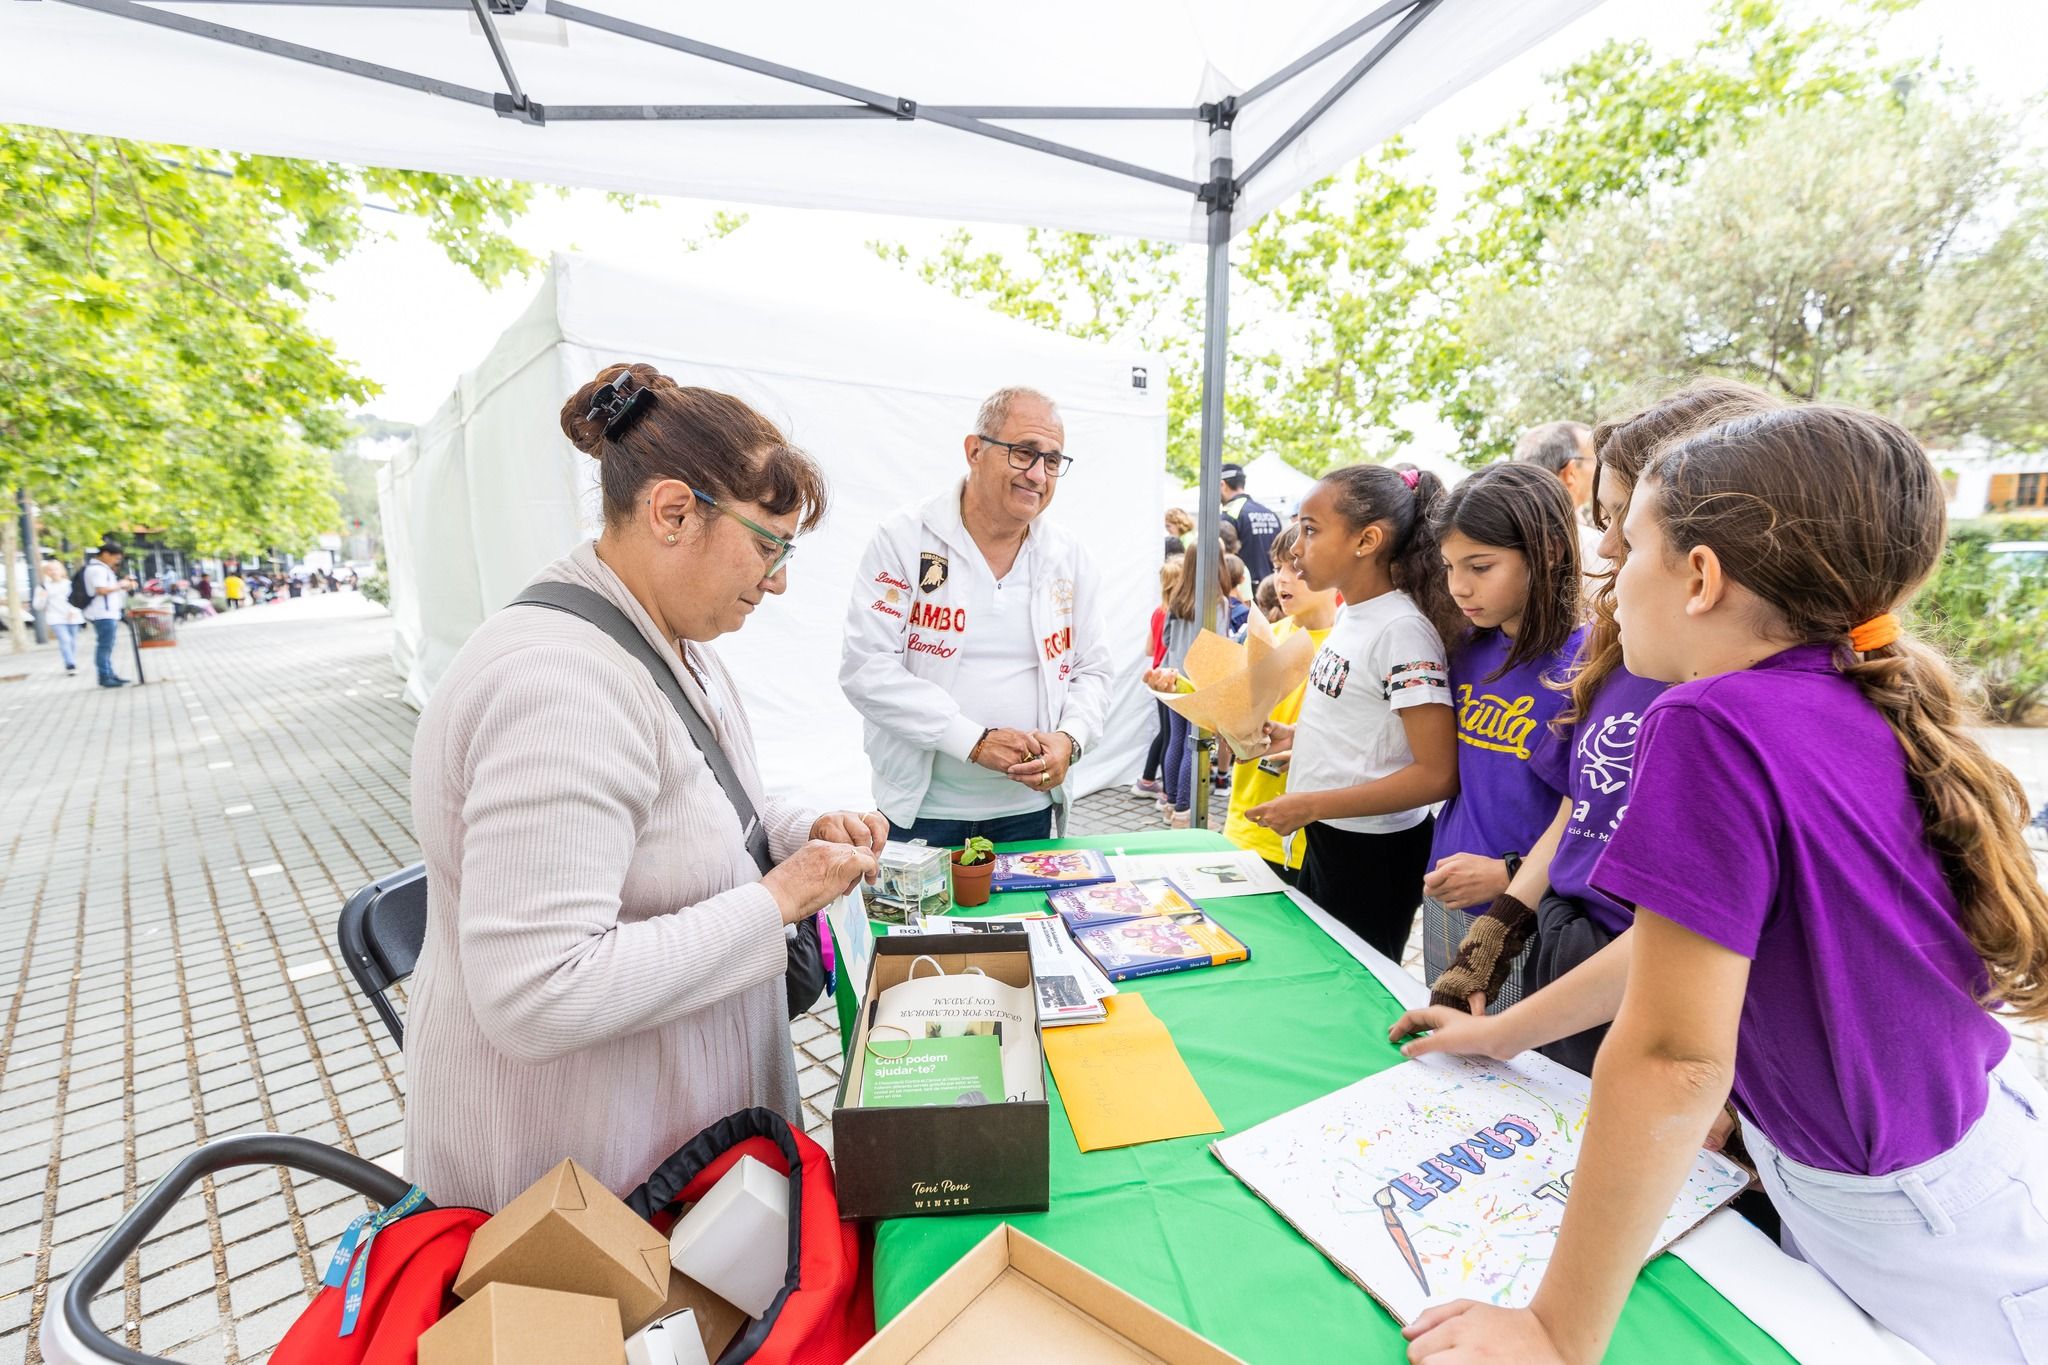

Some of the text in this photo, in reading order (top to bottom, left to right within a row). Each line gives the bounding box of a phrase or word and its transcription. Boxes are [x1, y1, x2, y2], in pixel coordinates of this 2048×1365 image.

[875, 571, 910, 590] Lambo
[871, 599, 903, 619] Team
[907, 632, 957, 658] Lambo
[1583, 829, 1596, 838] de
[1598, 832, 1611, 843] M
[900, 1009, 1022, 1023] GRACIAS POR COLABORAR
[875, 1053, 948, 1066] Com podem
[875, 1065, 936, 1078] ajudar-te?
[1388, 1114, 1542, 1212] CRAFT
[911, 1179, 971, 1196] Toni Pons
[914, 1197, 970, 1208] WINTER
